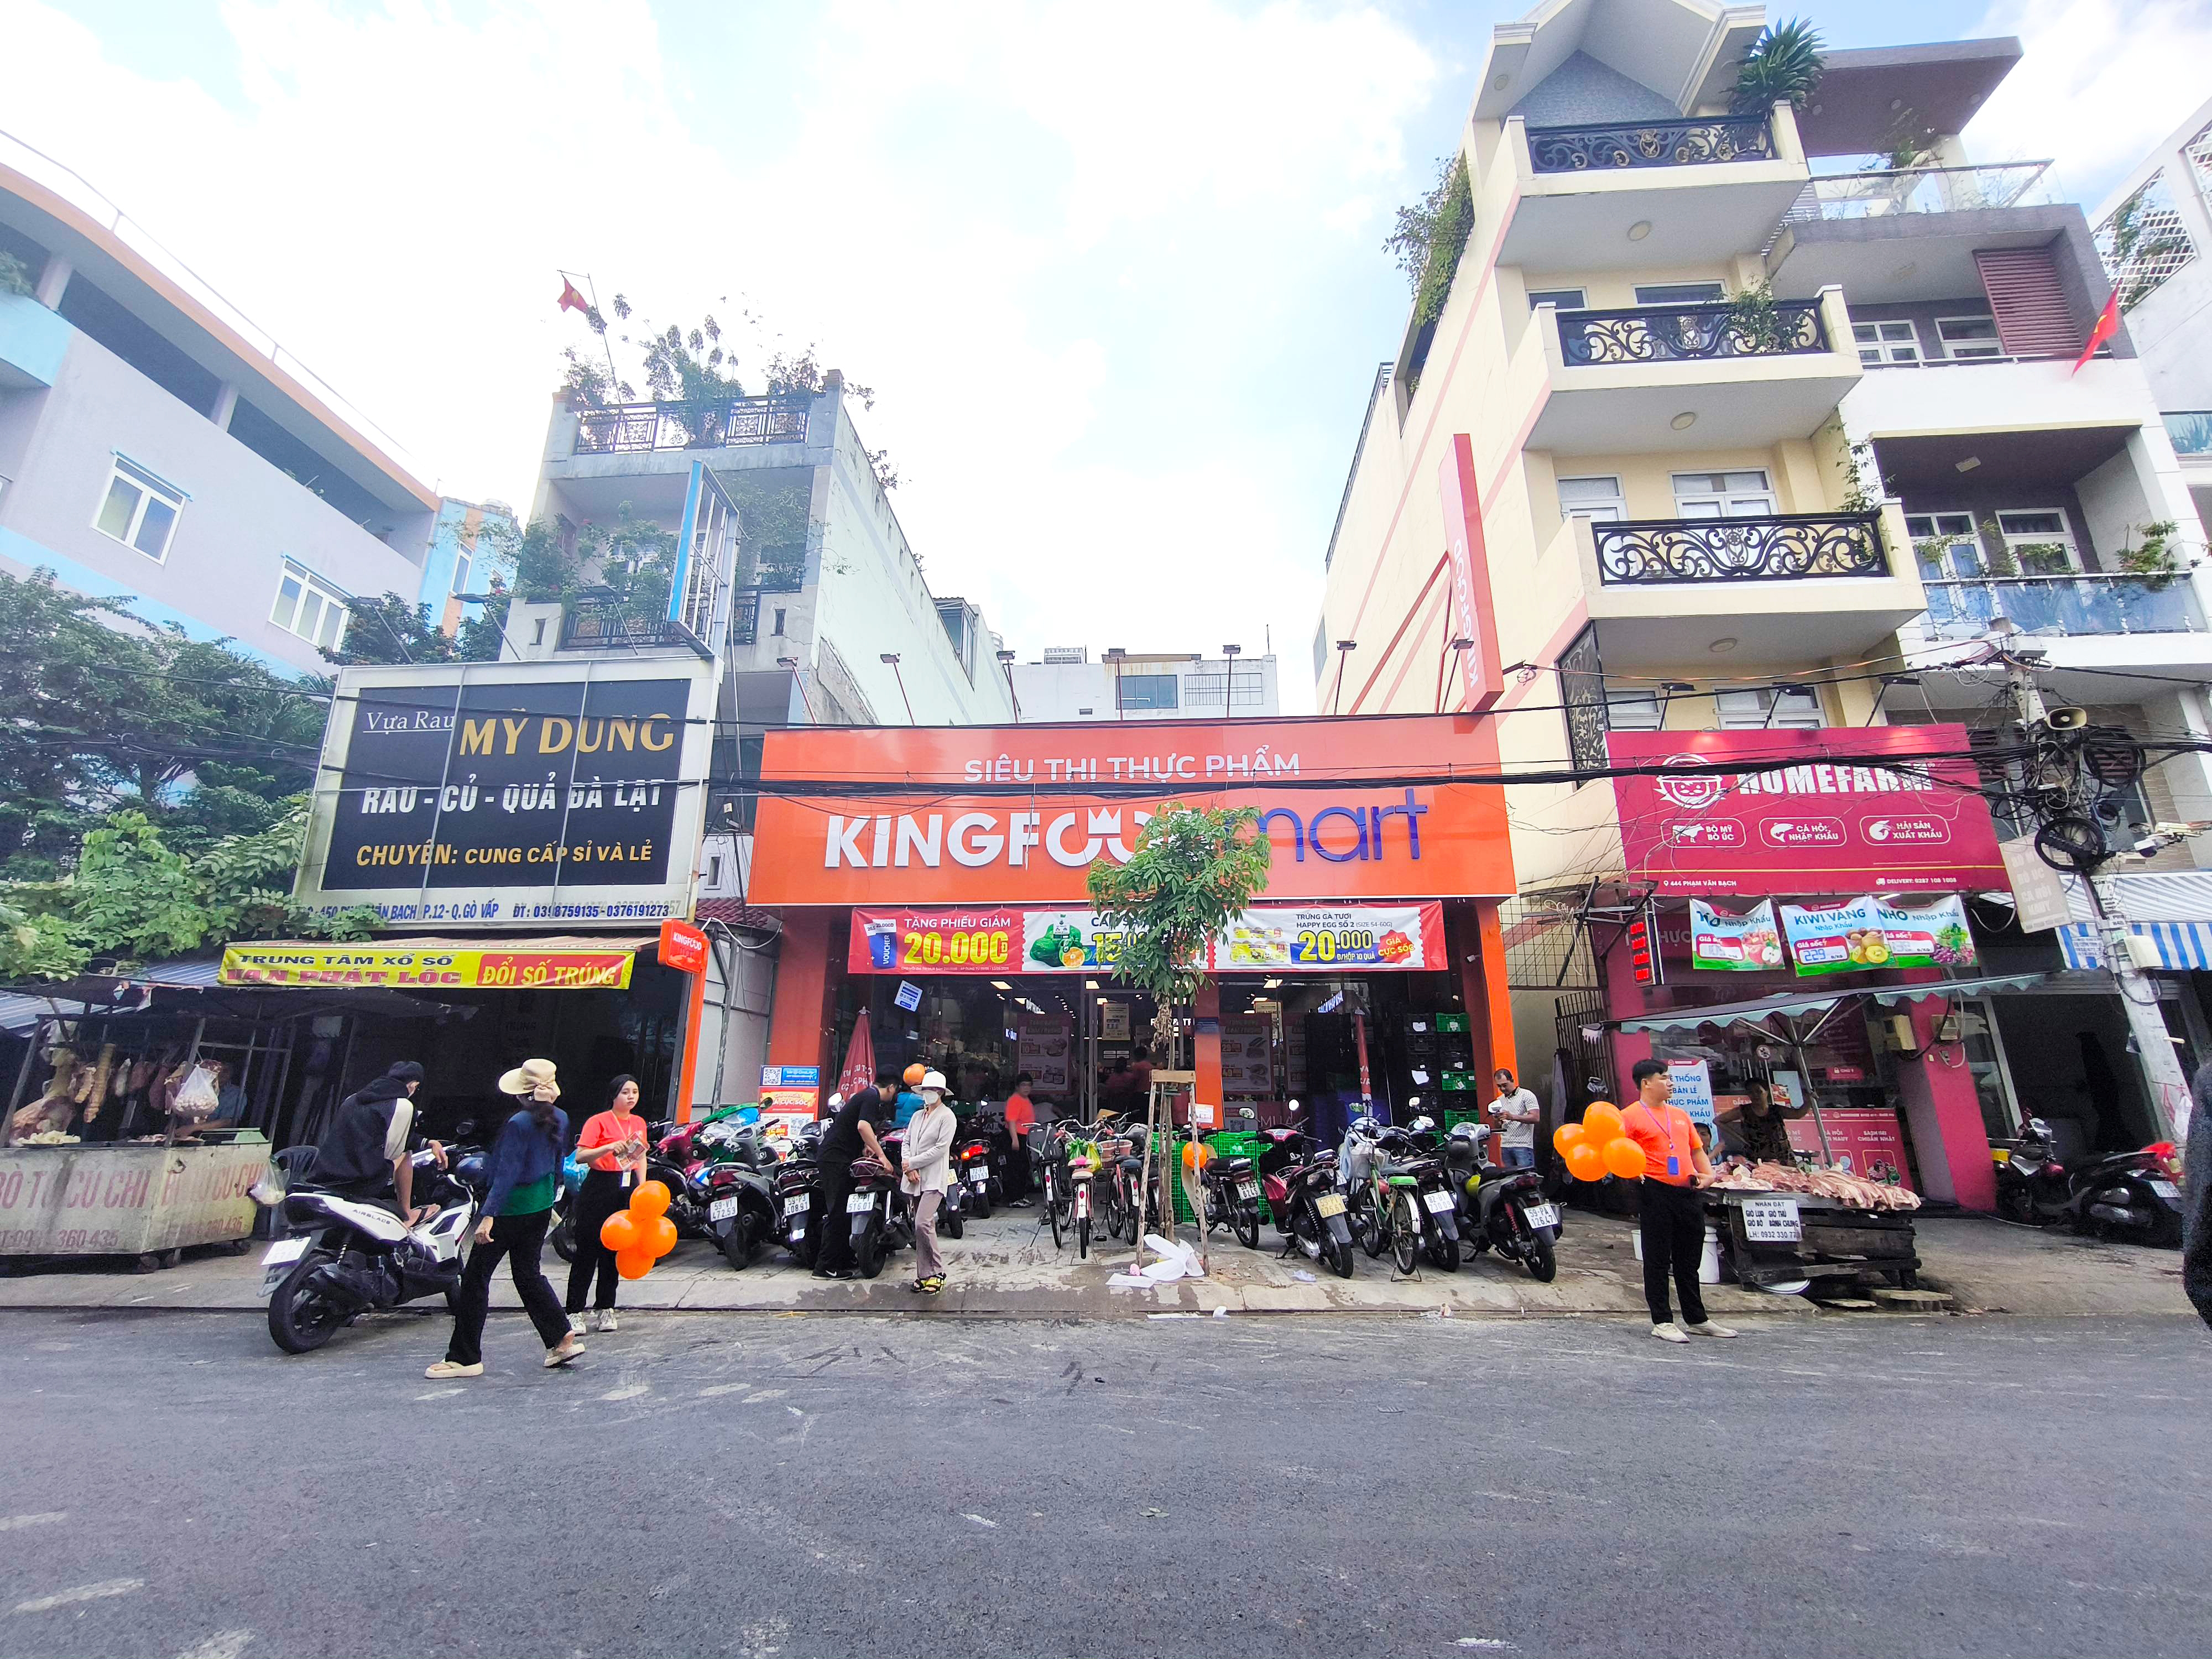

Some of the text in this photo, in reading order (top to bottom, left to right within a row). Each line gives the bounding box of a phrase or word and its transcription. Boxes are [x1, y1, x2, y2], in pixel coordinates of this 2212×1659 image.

[366, 712, 407, 734] Vựa
[413, 712, 454, 729] Rau
[539, 713, 674, 753] DUNG
[964, 744, 1300, 784] SIÊU THỊ THỰC PHẨM
[362, 786, 417, 813] RAU
[442, 774, 478, 812] CỦ
[503, 772, 556, 813] QUẢ
[570, 776, 602, 808] ĐÀ
[614, 779, 665, 812] LẠT
[1796, 824, 1810, 832] CÁ
[1896, 820, 1931, 830] HẢI SẢN
[1708, 832, 1735, 841] BÒ ÚC
[1814, 830, 1839, 840] KHẨU
[1892, 828, 1942, 839] XUẤT KHẨU
[357, 839, 653, 865] CHUYÊN: CUNG CẤP SỈ VÀ LẺ
[390, 905, 418, 922] BẠCH
[481, 898, 499, 918] VẤP
[904, 914, 1011, 930] TẶNG PHIẾU GIẢM
[1794, 909, 1866, 925] KIWI VÀNG
[673, 932, 702, 951] KINGFOOD
[1298, 930, 1373, 961] 20.000
[239, 953, 457, 965] TRUNG TÂM XỔ SỐ
[1803, 948, 1826, 961] 229
[300, 968, 462, 985] PHÁT LỘC
[482, 956, 617, 985] ĐỔI SỐ TRÚNG
[1676, 1073, 1701, 1082] THỐNG
[1687, 1095, 1709, 1105] PHẨM
[1690, 1107, 1710, 1117] KHẨU
[714, 1199, 733, 1211] 59-V1
[712, 1207, 736, 1219] 472.53
[1529, 1206, 1549, 1218] 59-PA
[1531, 1215, 1555, 1227] 126.47
